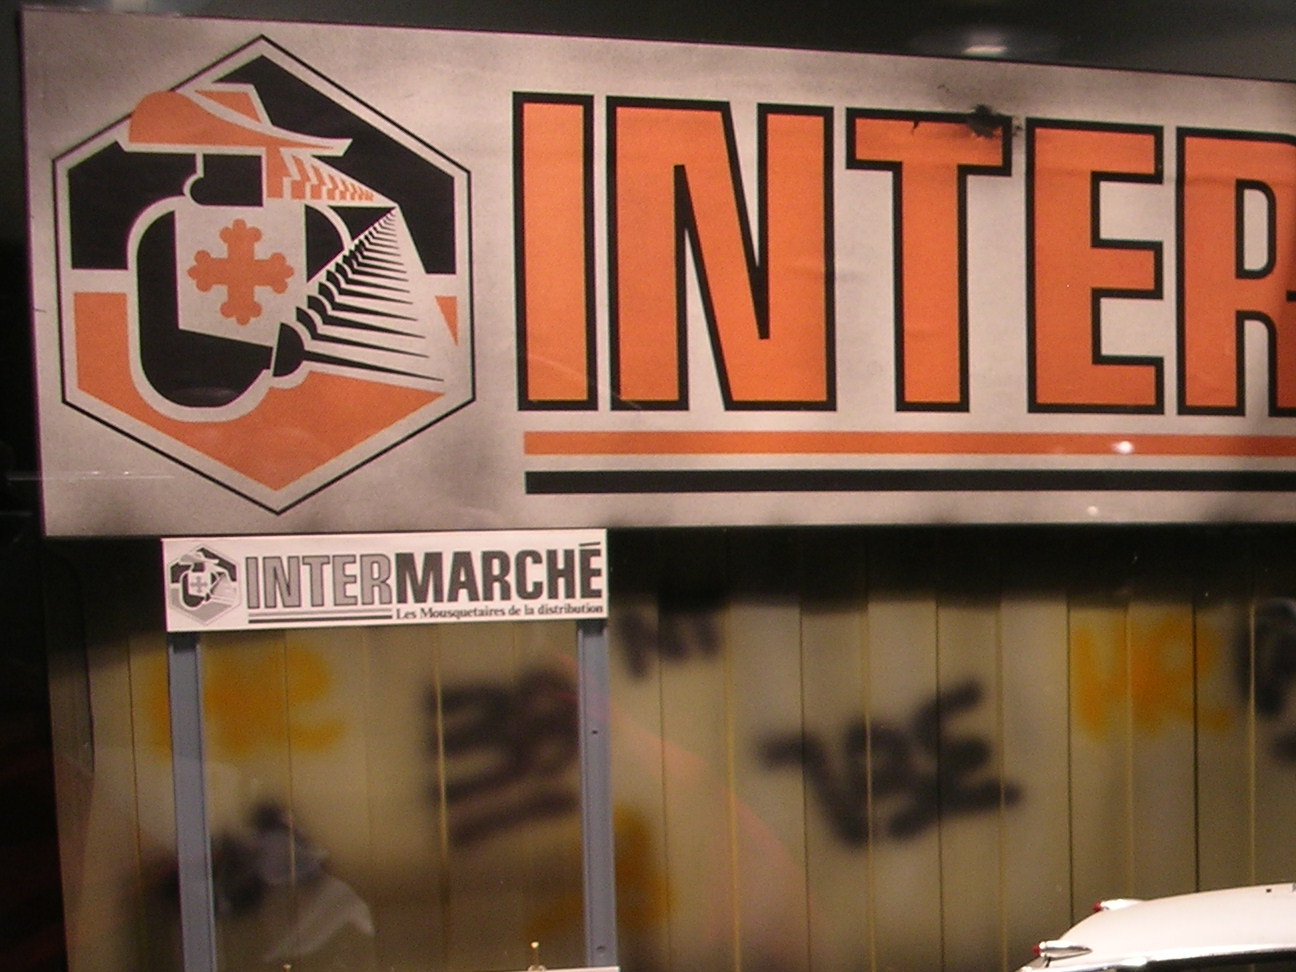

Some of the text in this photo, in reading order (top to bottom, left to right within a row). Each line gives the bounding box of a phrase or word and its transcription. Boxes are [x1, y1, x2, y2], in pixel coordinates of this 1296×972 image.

[245, 542, 603, 609] INTERMARCHÉ
[396, 602, 604, 622] Les Mousquetaires de la distribution
